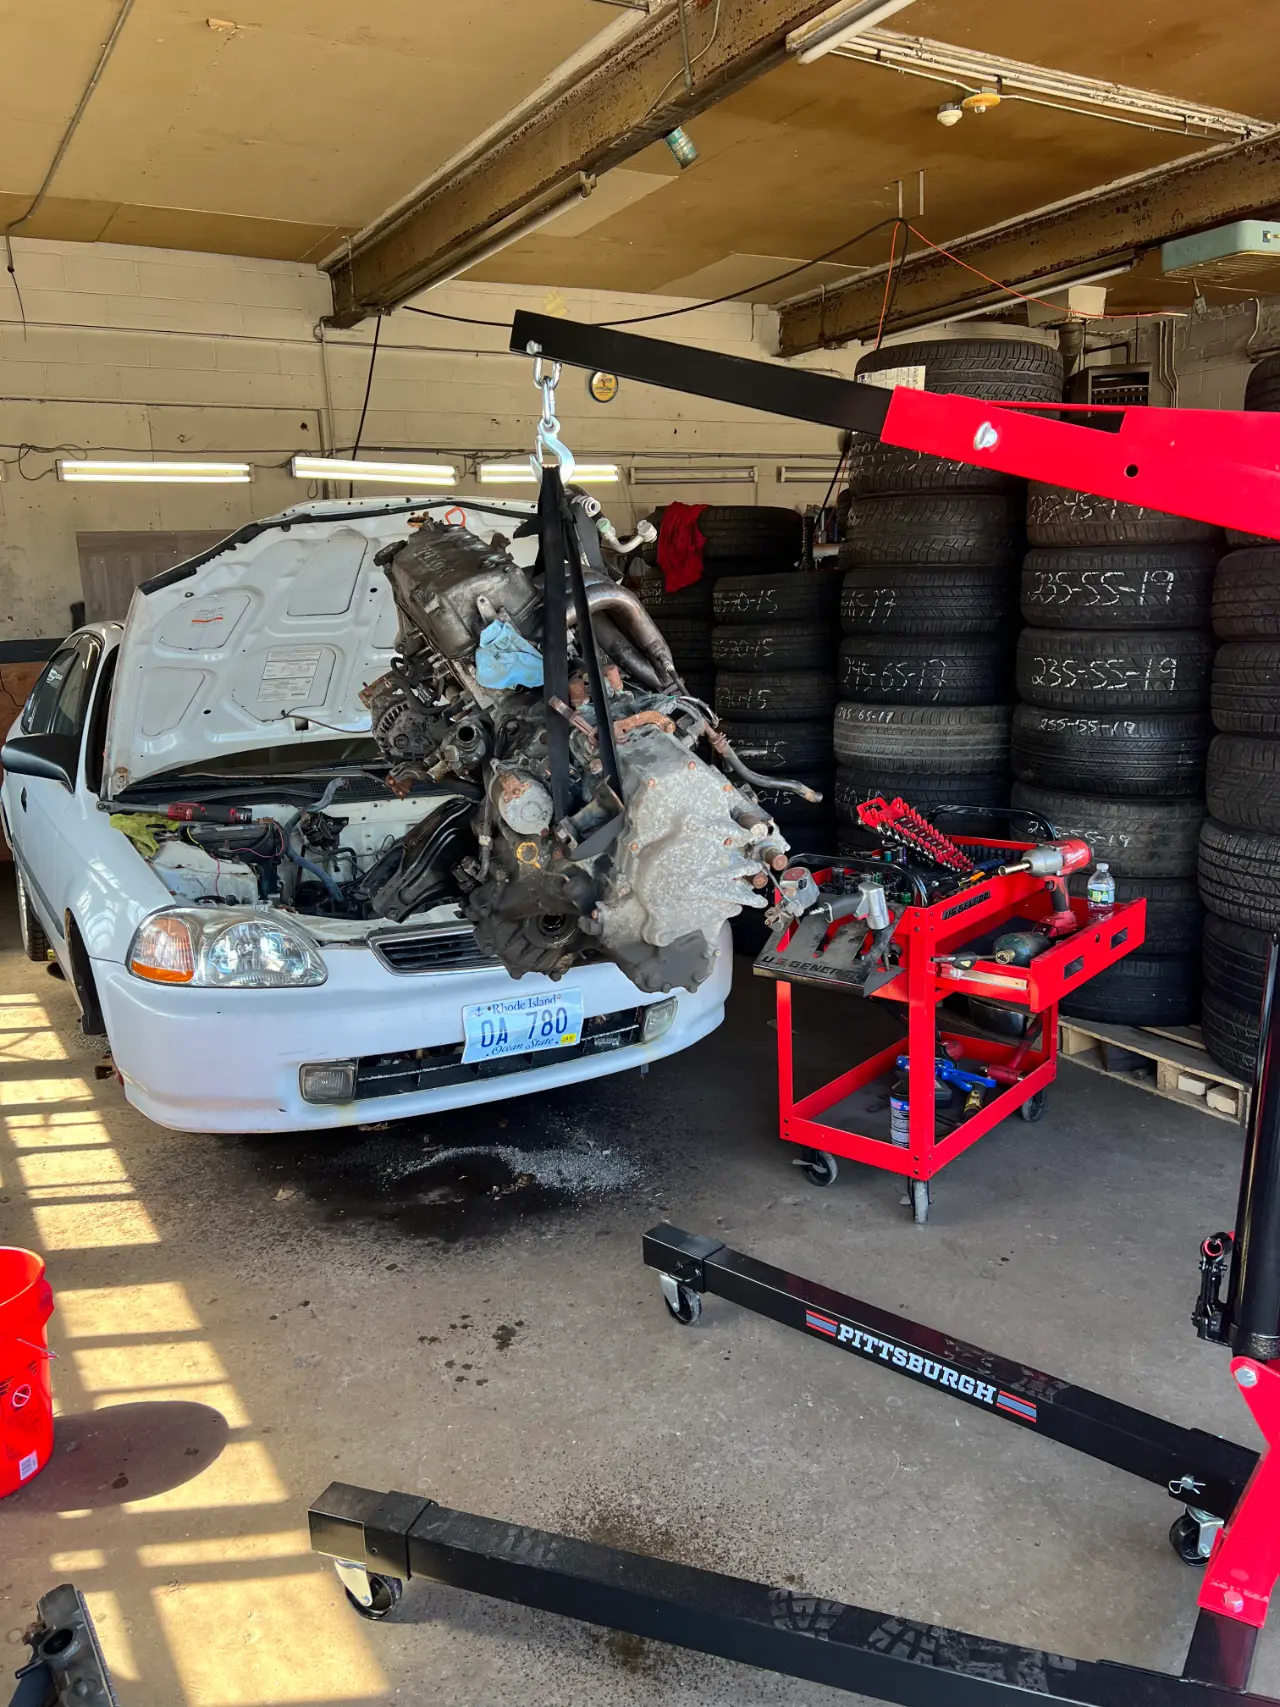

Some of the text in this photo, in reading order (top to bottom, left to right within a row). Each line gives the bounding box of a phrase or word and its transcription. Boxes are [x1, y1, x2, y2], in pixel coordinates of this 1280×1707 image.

[1031, 571, 1174, 606] 235-55-19
[1031, 657, 1177, 691] 235-55-19
[492, 994, 557, 1014] Rhode Island
[525, 1007, 568, 1040] 780
[491, 1043, 523, 1055] Ocean
[525, 1038, 554, 1050] State
[837, 1323, 997, 1405] PITTSBURGH
